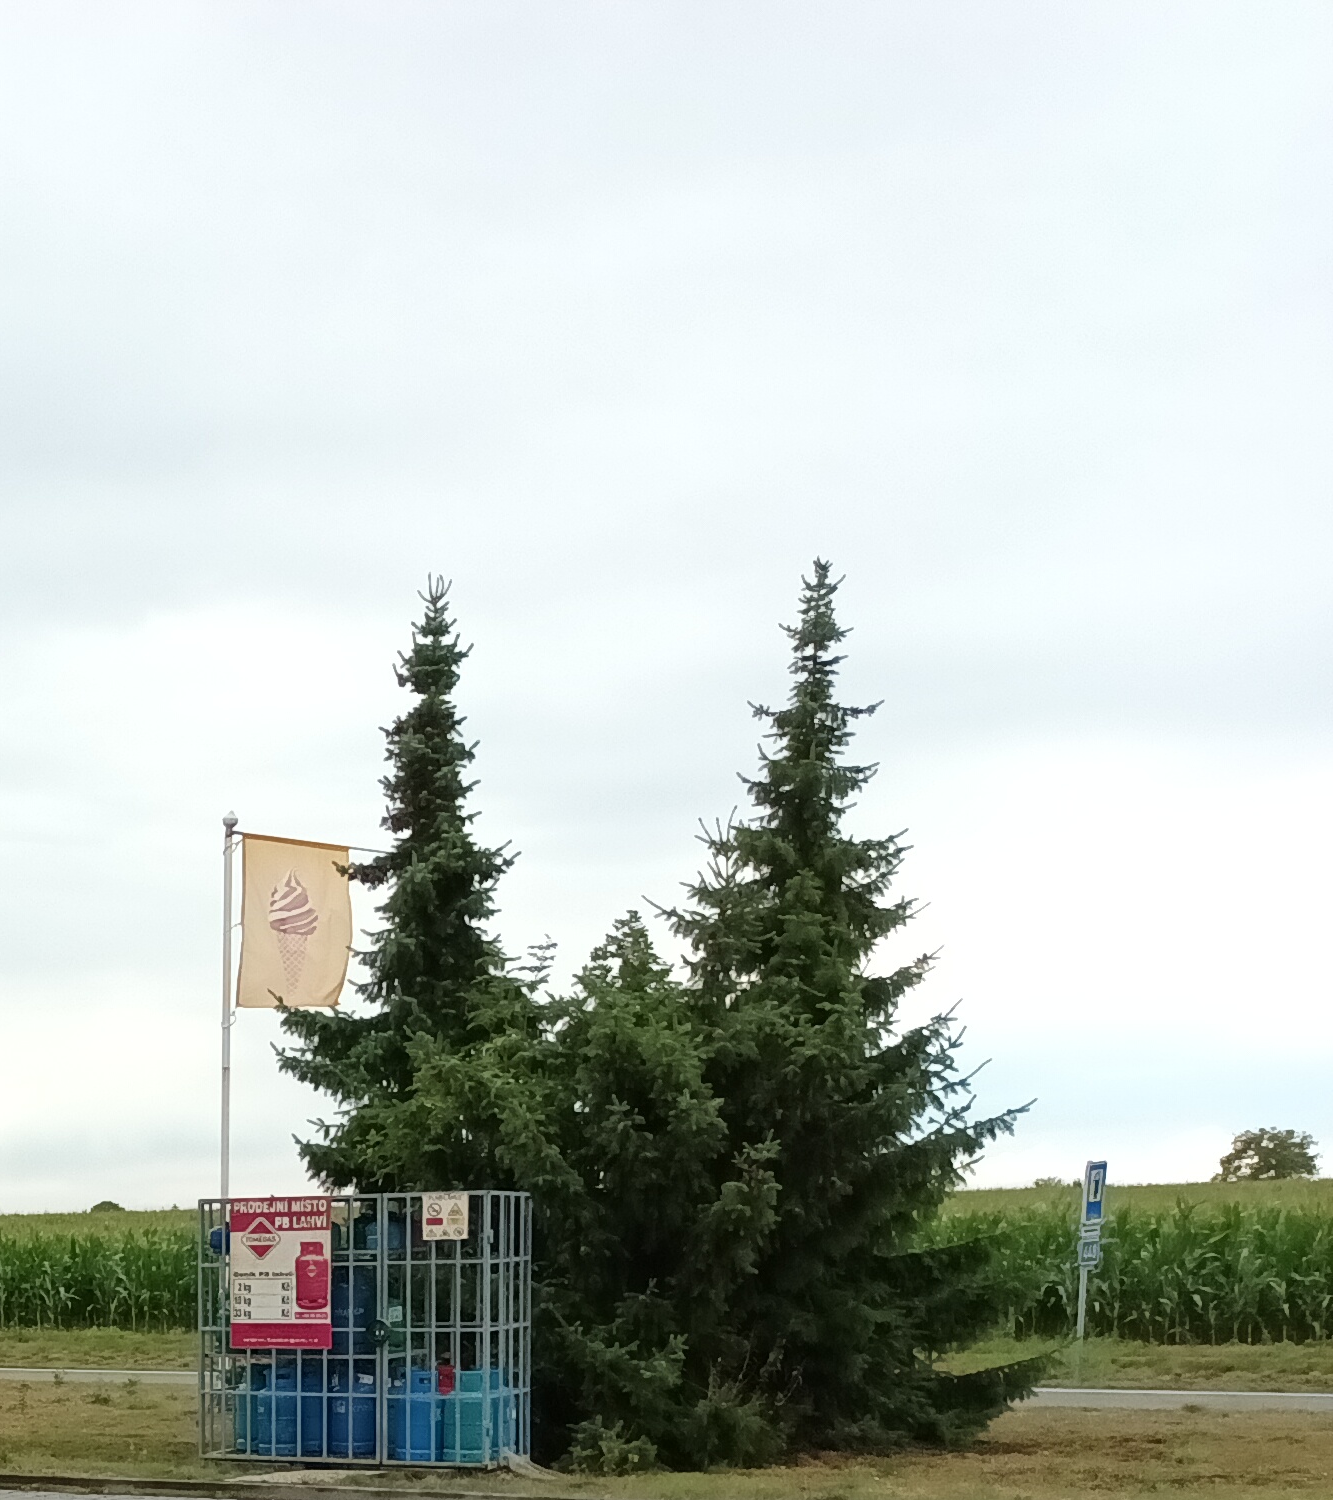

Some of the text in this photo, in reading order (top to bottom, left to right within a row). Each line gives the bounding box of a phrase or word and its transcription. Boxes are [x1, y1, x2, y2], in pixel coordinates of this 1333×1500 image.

[234, 1198, 327, 1214] PRODEJNÍ MÍSTO
[274, 1213, 327, 1229] PB LAHVÍ
